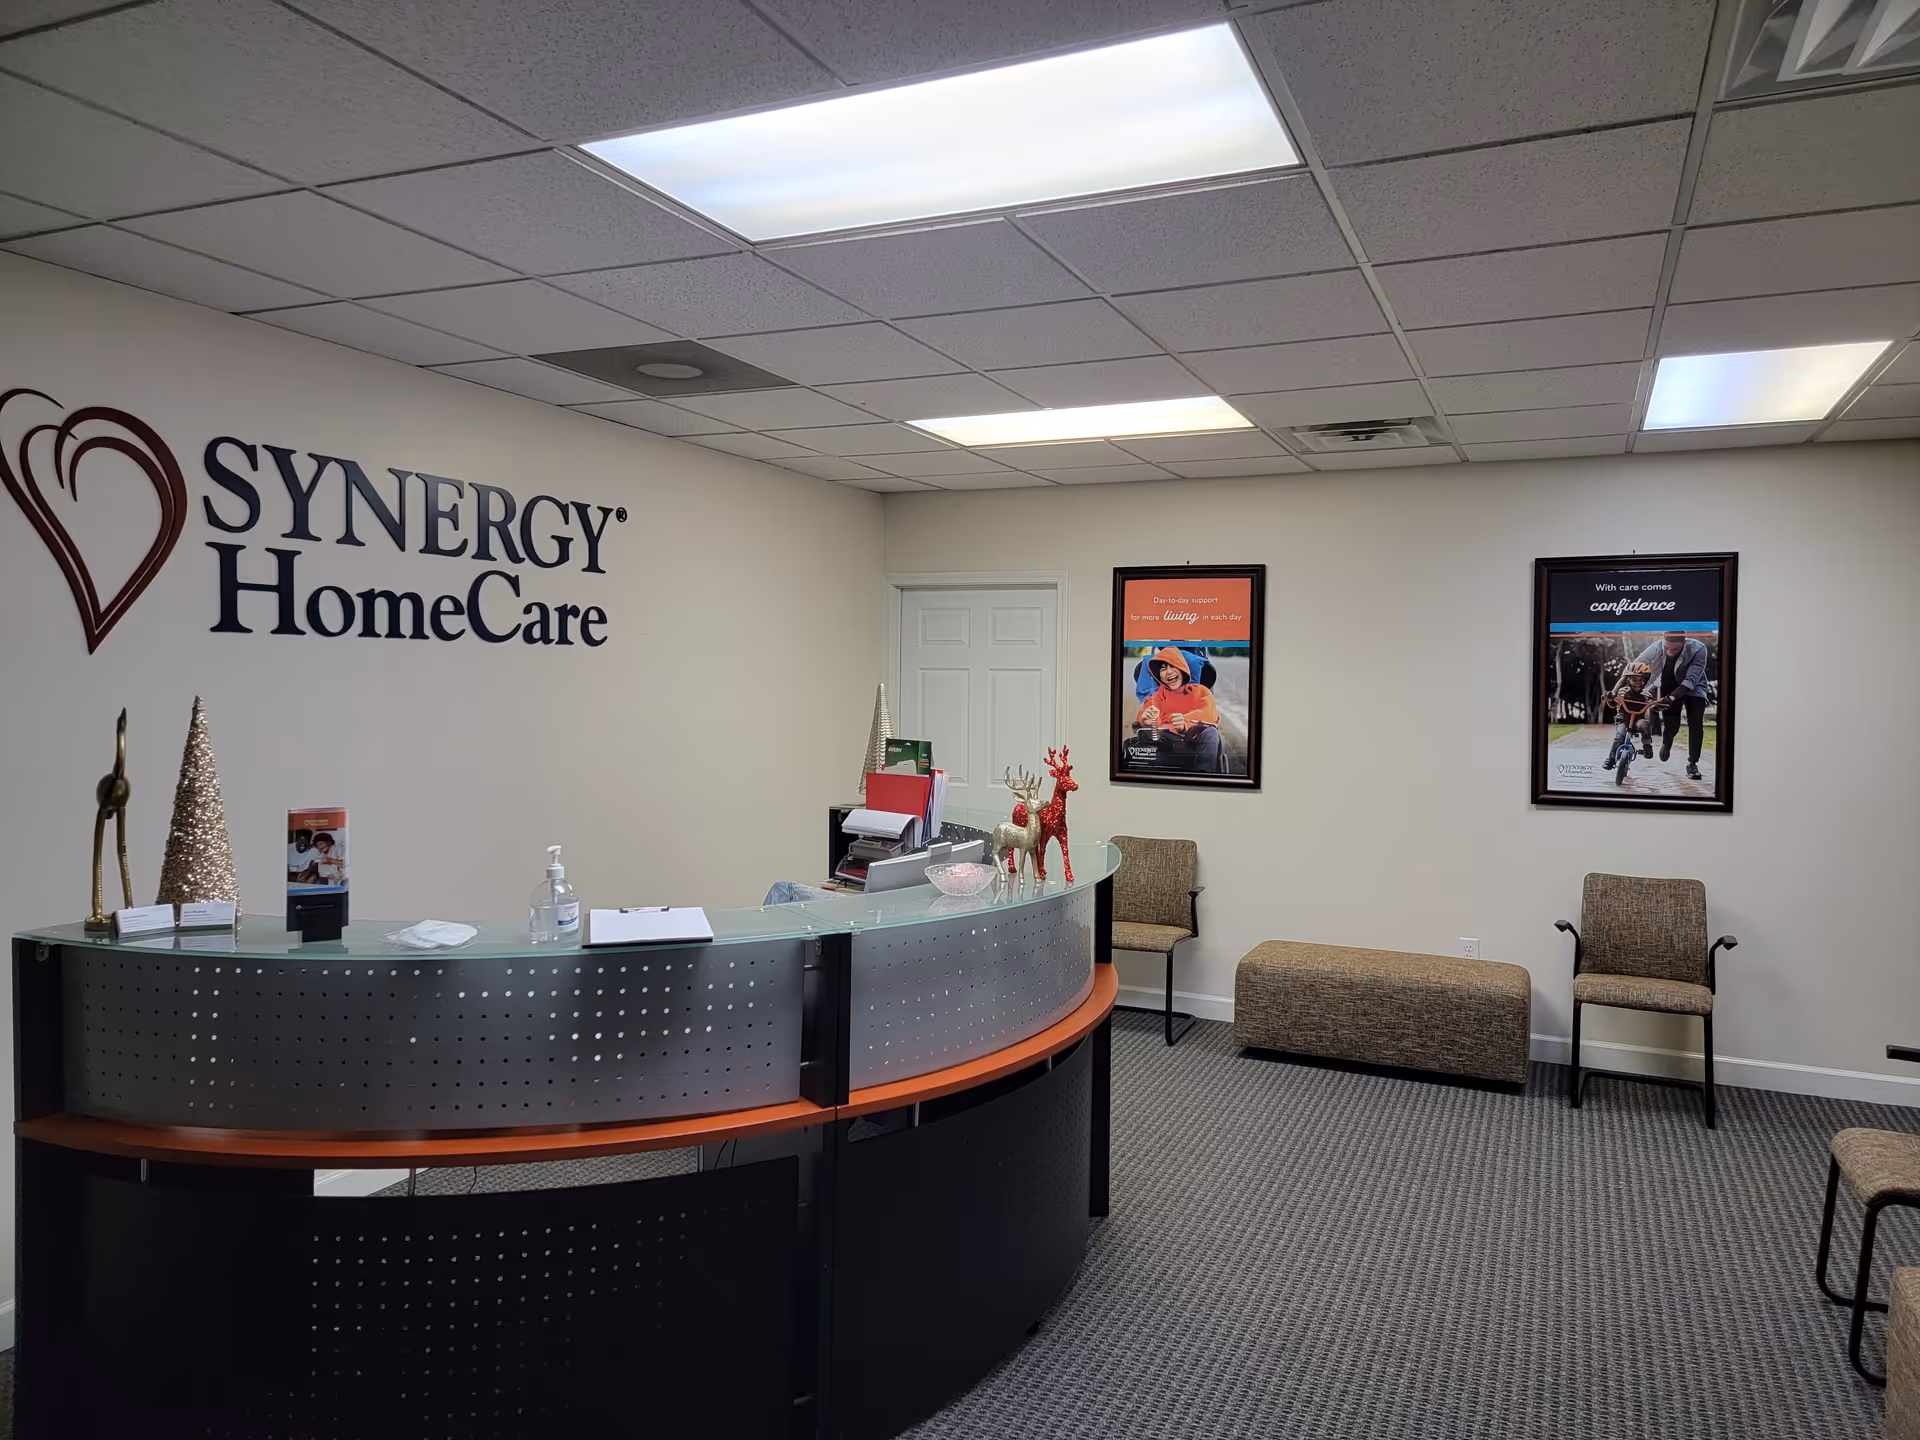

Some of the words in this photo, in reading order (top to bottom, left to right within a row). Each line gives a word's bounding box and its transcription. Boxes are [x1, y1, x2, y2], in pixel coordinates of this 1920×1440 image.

[205, 541, 608, 647] HomeCare
[1595, 583, 1616, 591] With
[1589, 597, 1676, 616] confidence
[1163, 609, 1199, 624] living
[1210, 613, 1227, 621] each
[1229, 613, 1242, 622] day
